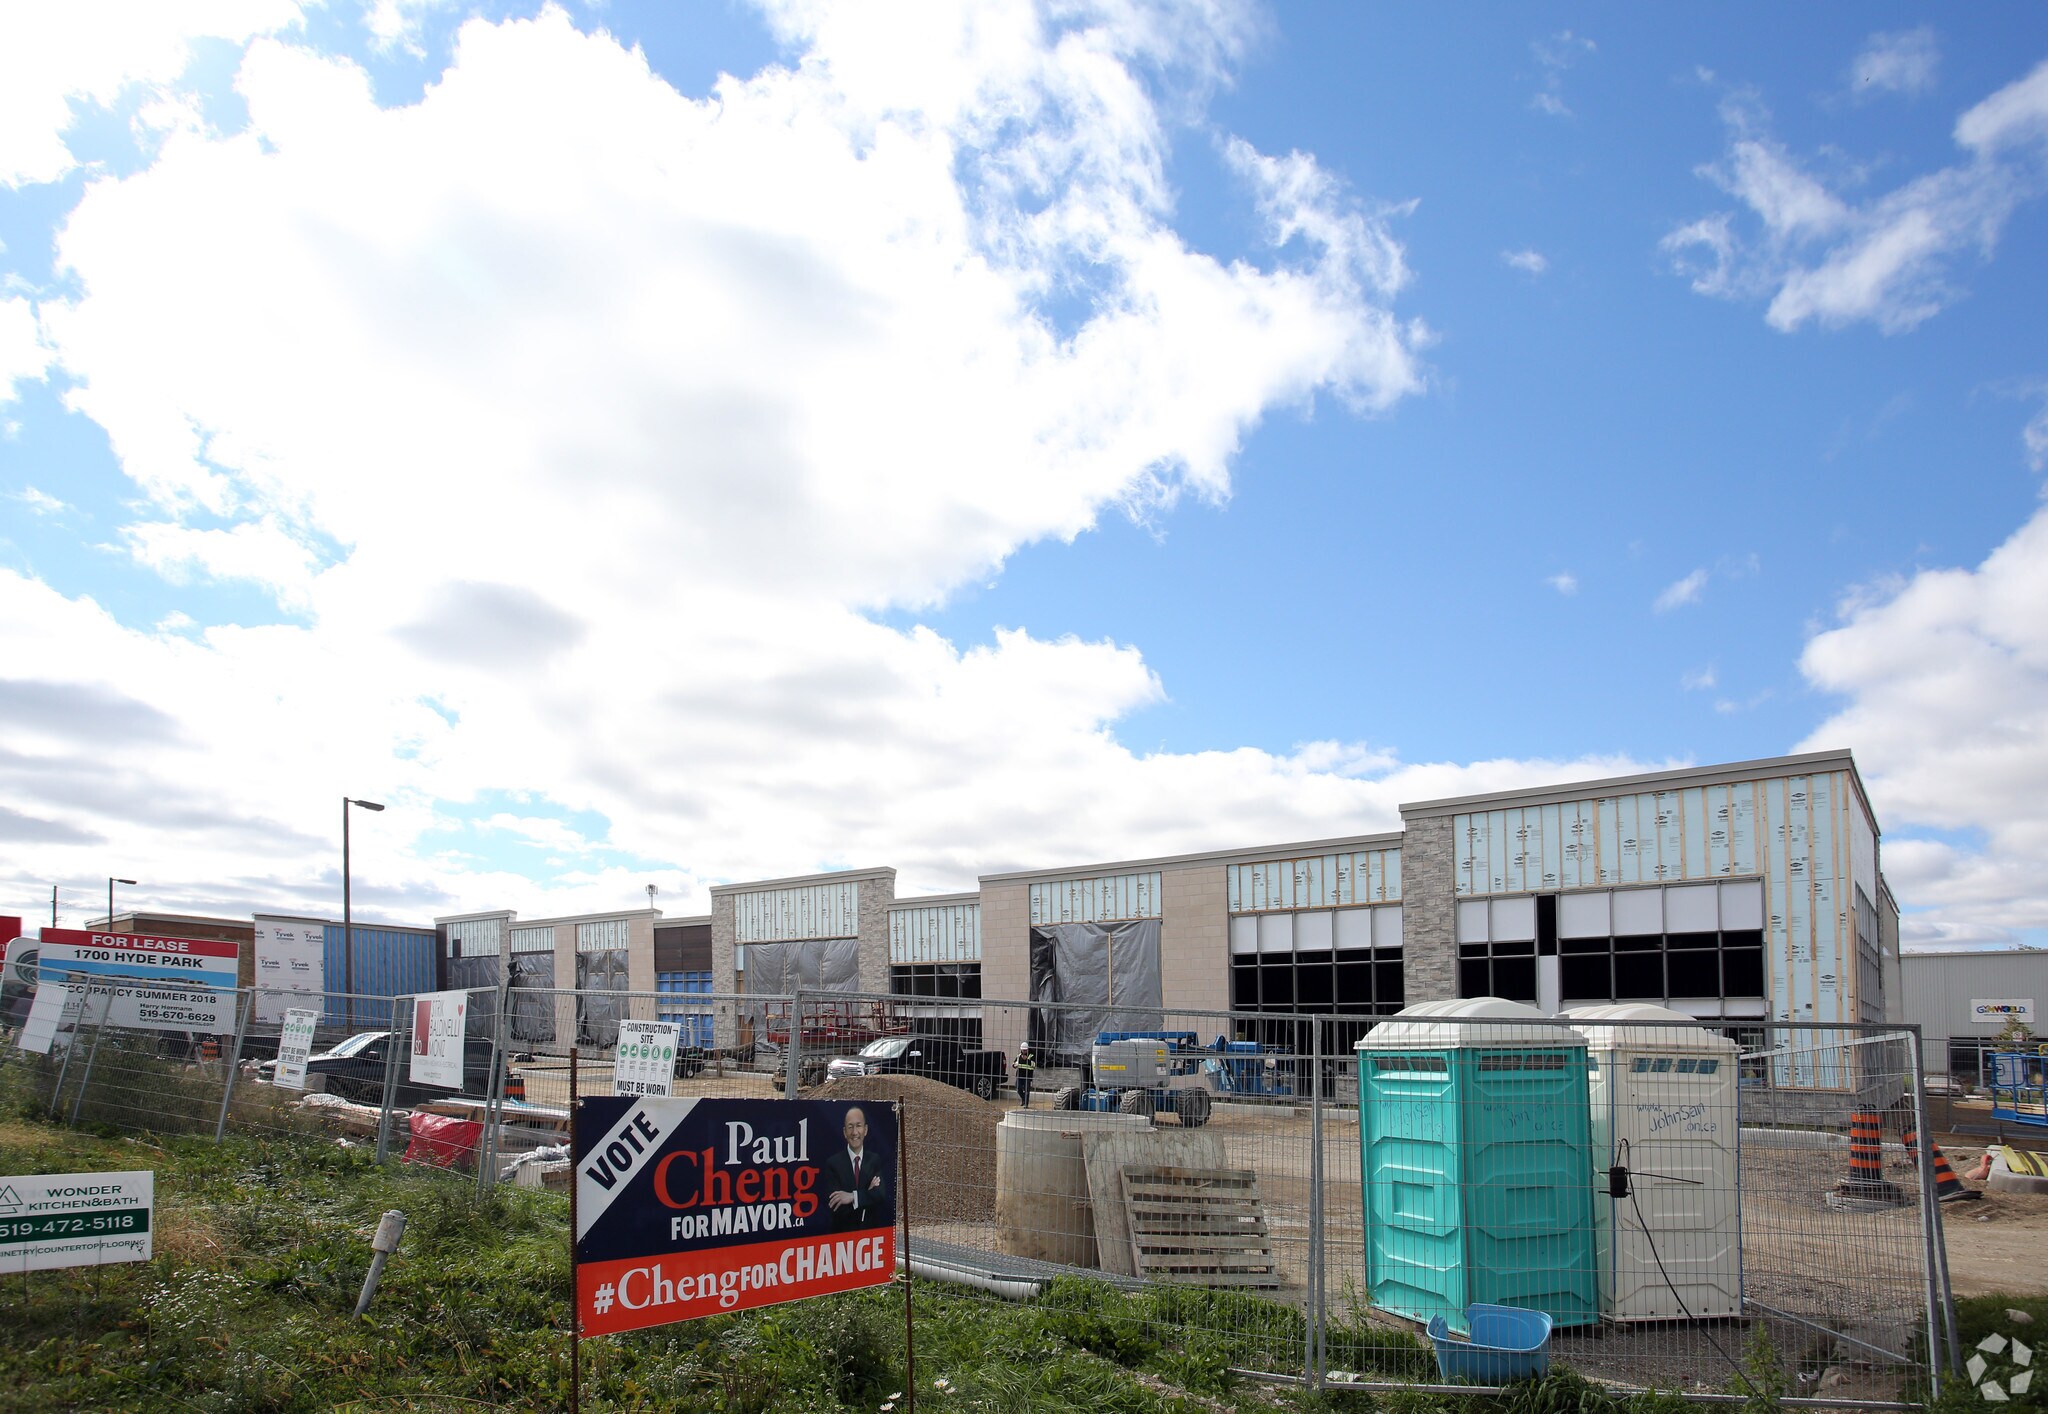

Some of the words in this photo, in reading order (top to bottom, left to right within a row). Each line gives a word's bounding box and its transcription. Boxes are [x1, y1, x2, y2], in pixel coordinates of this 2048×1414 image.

[91, 934, 128, 947] FOR
[133, 938, 188, 952] LEASE
[74, 949, 110, 961] 1700
[115, 952, 157, 964] HYDE
[162, 956, 203, 968] PARK
[58, 984, 132, 997] CCUPANCY
[135, 990, 187, 1002] SUMMER
[190, 994, 217, 1004] 2018
[139, 1009, 216, 1022] 519-670-6629
[1976, 1005, 2026, 1014] GYMWORLD
[627, 1022, 673, 1035] CONSTRUCTION
[640, 1034, 654, 1044] SITE
[617, 1080, 634, 1092] MUST
[636, 1082, 645, 1093] BE
[646, 1083, 666, 1096] WORN
[1650, 1102, 1706, 1133] JohnSan
[585, 1110, 660, 1191] VOTE
[724, 1117, 810, 1166] Paul
[652, 1146, 820, 1218] Cheng
[47, 1185, 122, 1198] WONDER
[29, 1197, 139, 1211] KITCHEN&BATH
[0, 1215, 134, 1238] 519-472-5118
